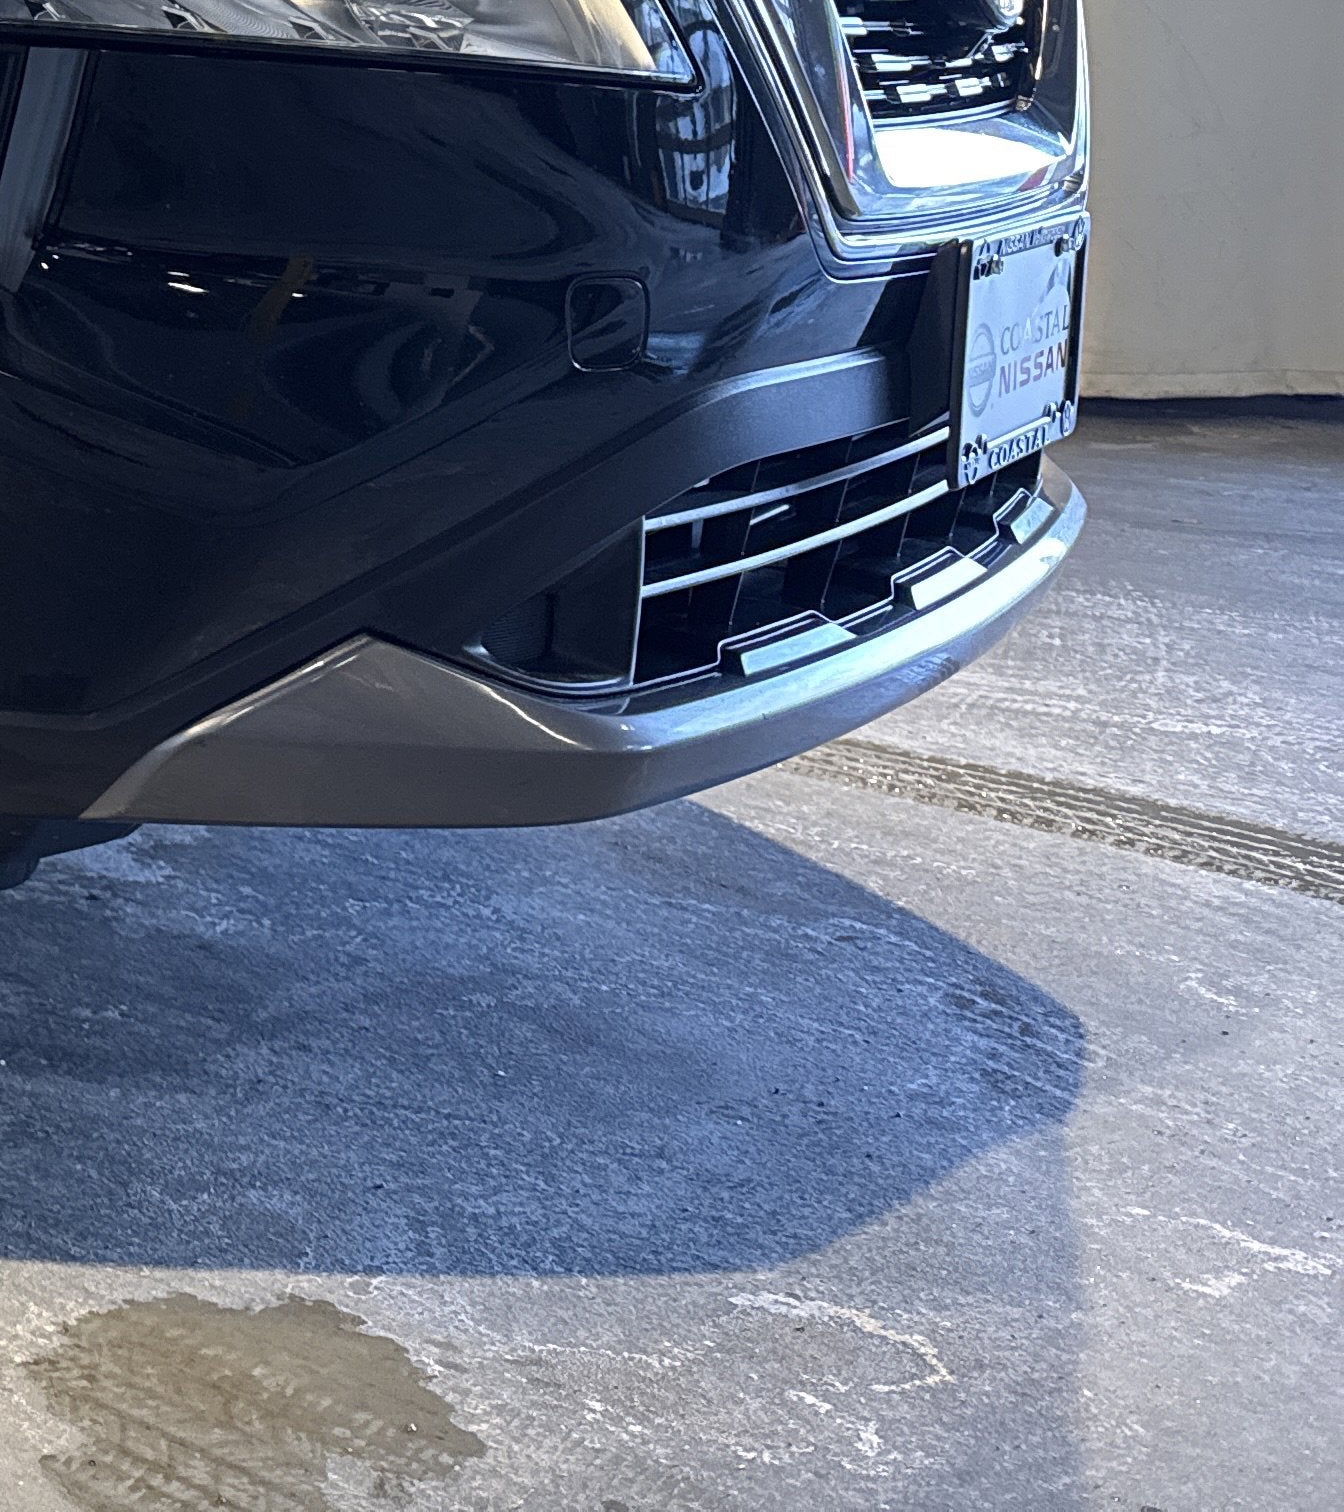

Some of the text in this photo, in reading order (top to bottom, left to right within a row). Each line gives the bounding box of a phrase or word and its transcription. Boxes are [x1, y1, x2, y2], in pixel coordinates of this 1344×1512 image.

[1000, 303, 1069, 355] COASTAL
[998, 338, 1068, 398] NISSAN
[988, 423, 1050, 470] COASTAL
